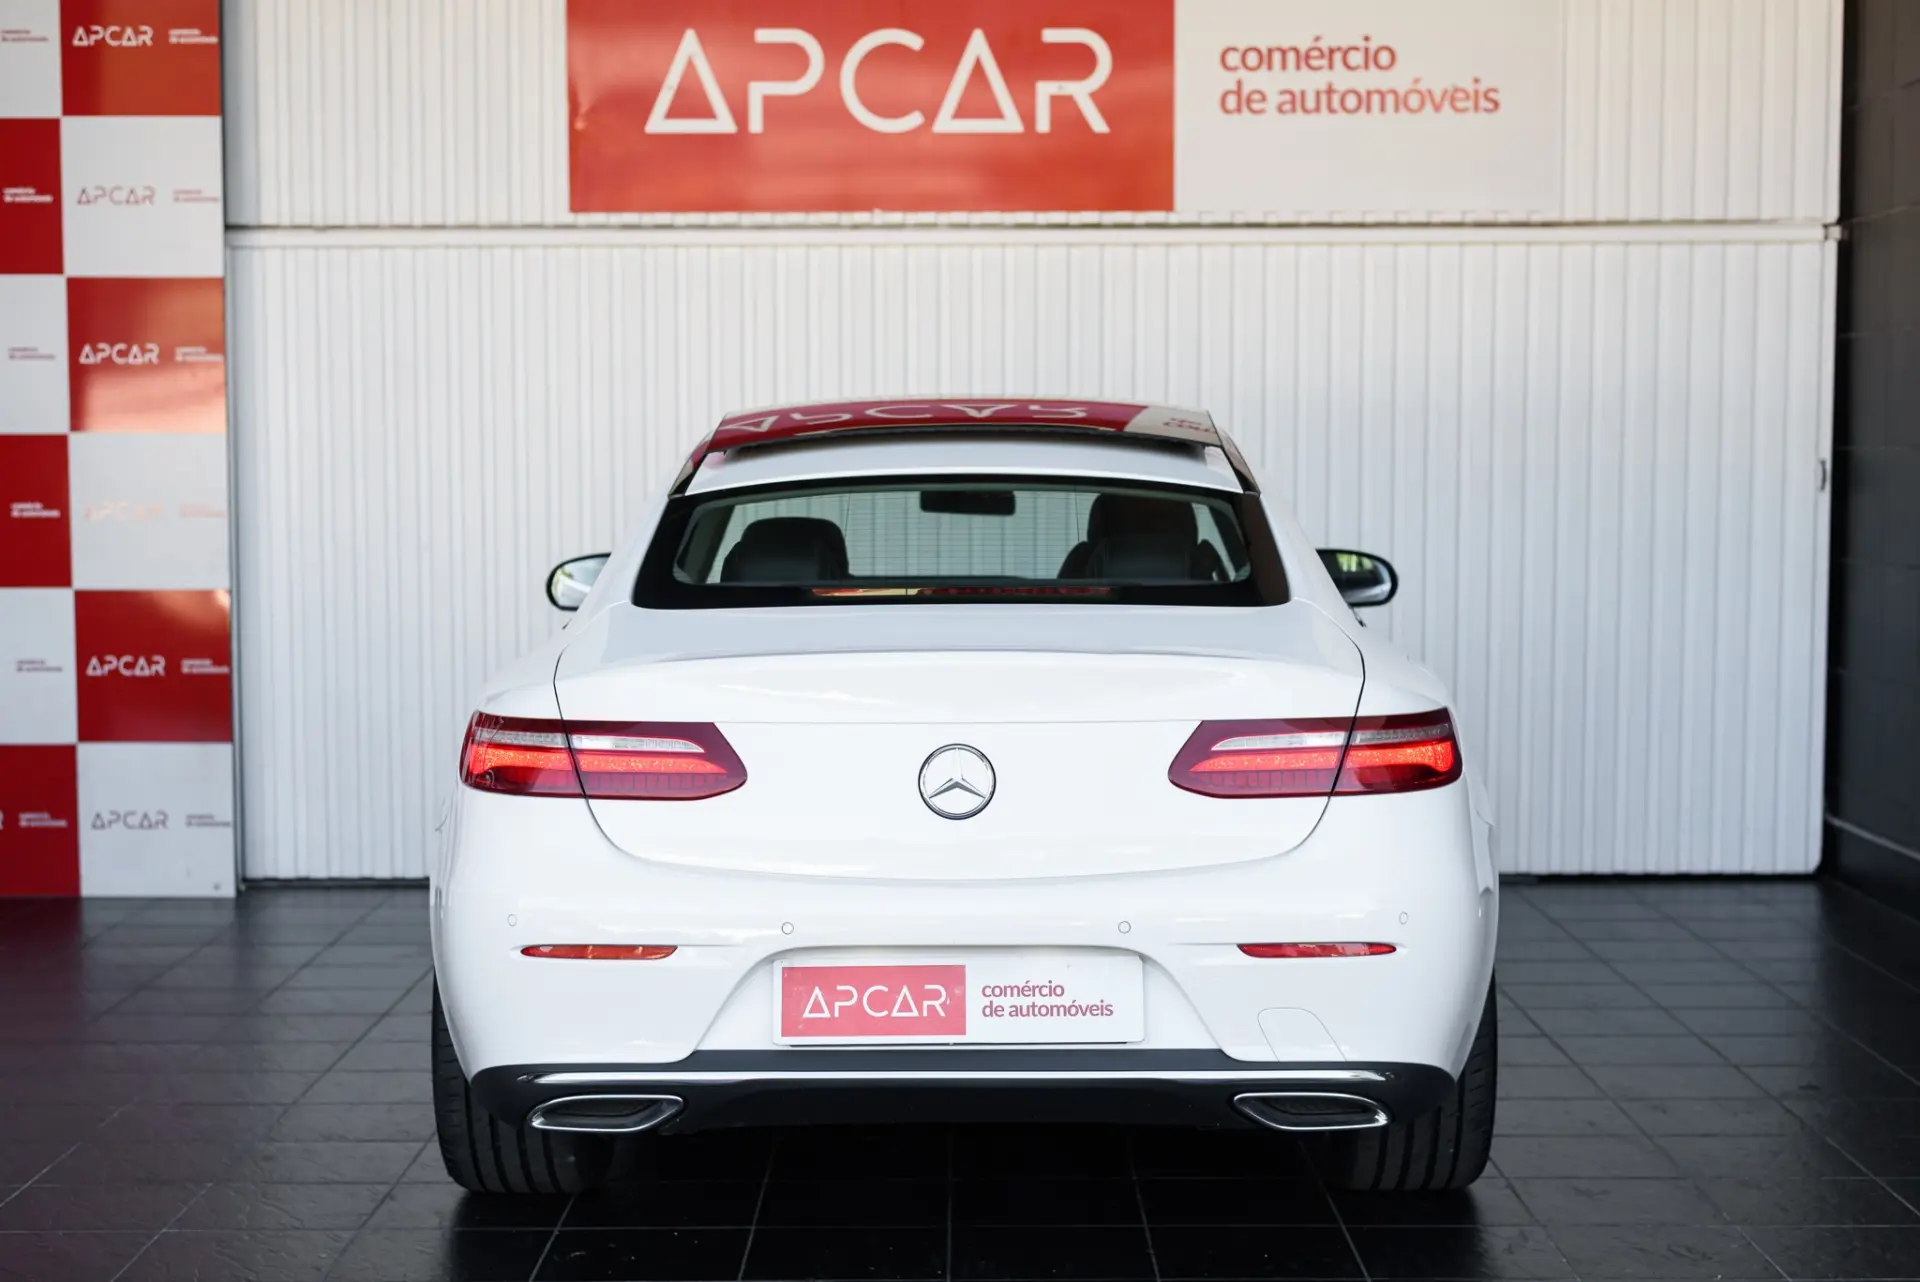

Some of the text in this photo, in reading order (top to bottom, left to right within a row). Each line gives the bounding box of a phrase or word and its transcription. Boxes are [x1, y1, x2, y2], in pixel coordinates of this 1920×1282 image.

[73, 26, 153, 46] APCAR
[1220, 35, 1397, 73] comércio
[644, 28, 1113, 134] APCAR
[1220, 76, 1500, 115] de automóveis
[77, 186, 156, 205] APCAR
[79, 343, 159, 364] APCAR
[86, 655, 165, 676] APCAR
[91, 810, 169, 830] APCAR
[982, 980, 1065, 998] comércio
[803, 984, 946, 1018] APCAR
[982, 999, 1113, 1017] de automóveis
